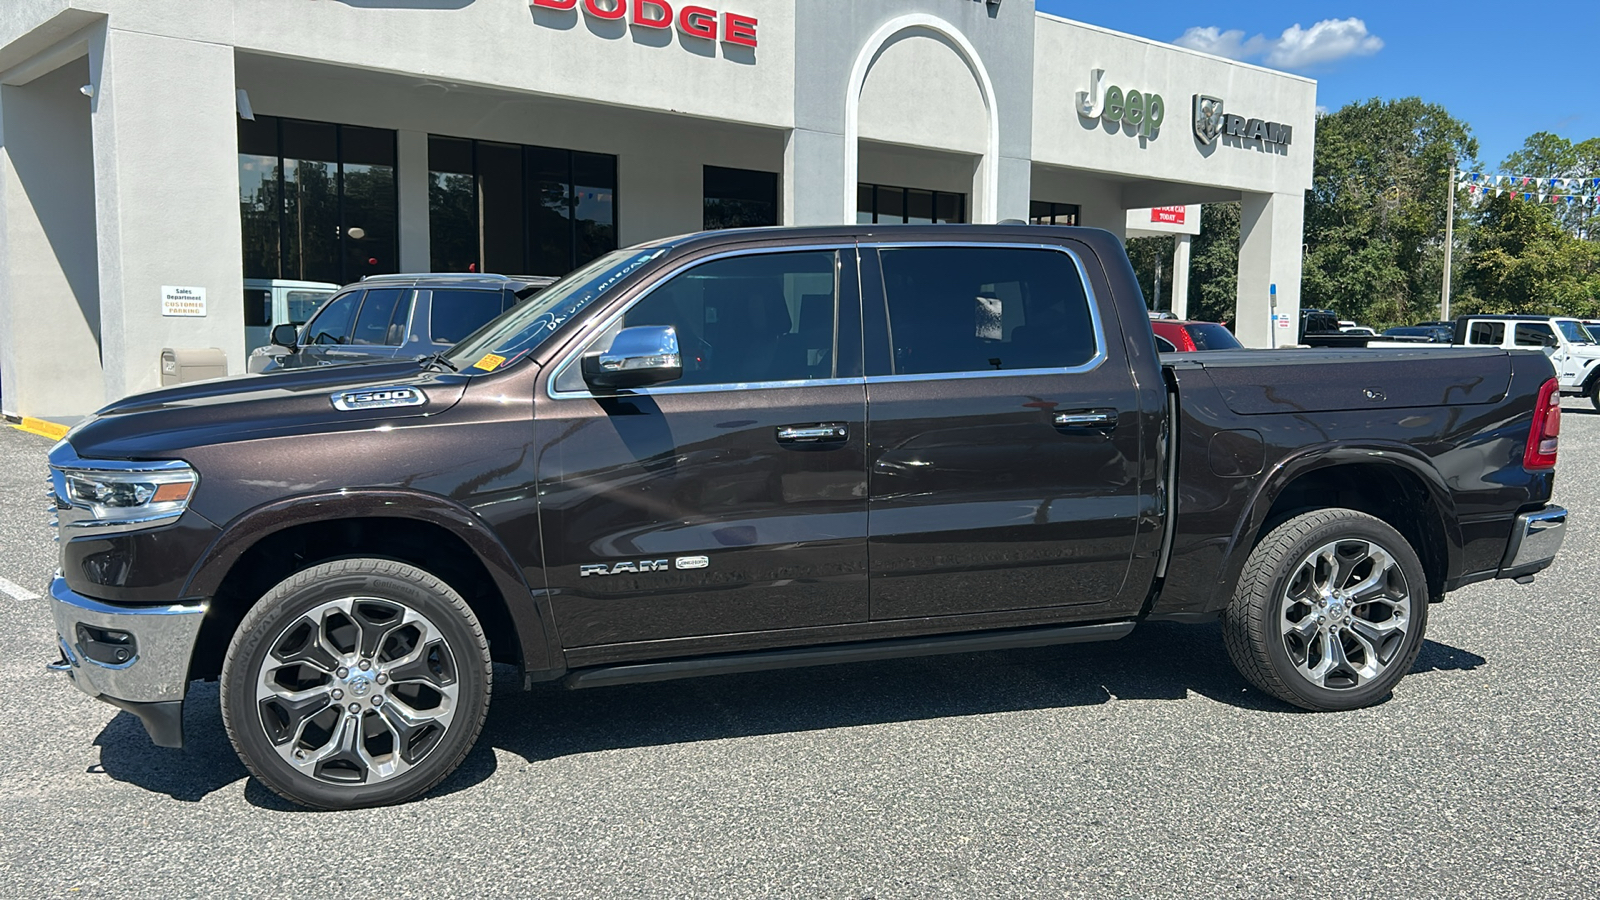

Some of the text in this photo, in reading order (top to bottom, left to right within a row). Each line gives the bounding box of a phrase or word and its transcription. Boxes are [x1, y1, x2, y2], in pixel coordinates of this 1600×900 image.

[531, 0, 758, 47] ODGE
[1075, 68, 1165, 137] Jeep
[1225, 113, 1293, 145] RAM
[1159, 213, 1176, 221] TODAY
[345, 390, 411, 403] 1500
[1281, 522, 1348, 574] CONTINENTAL
[580, 559, 669, 577] RAM
